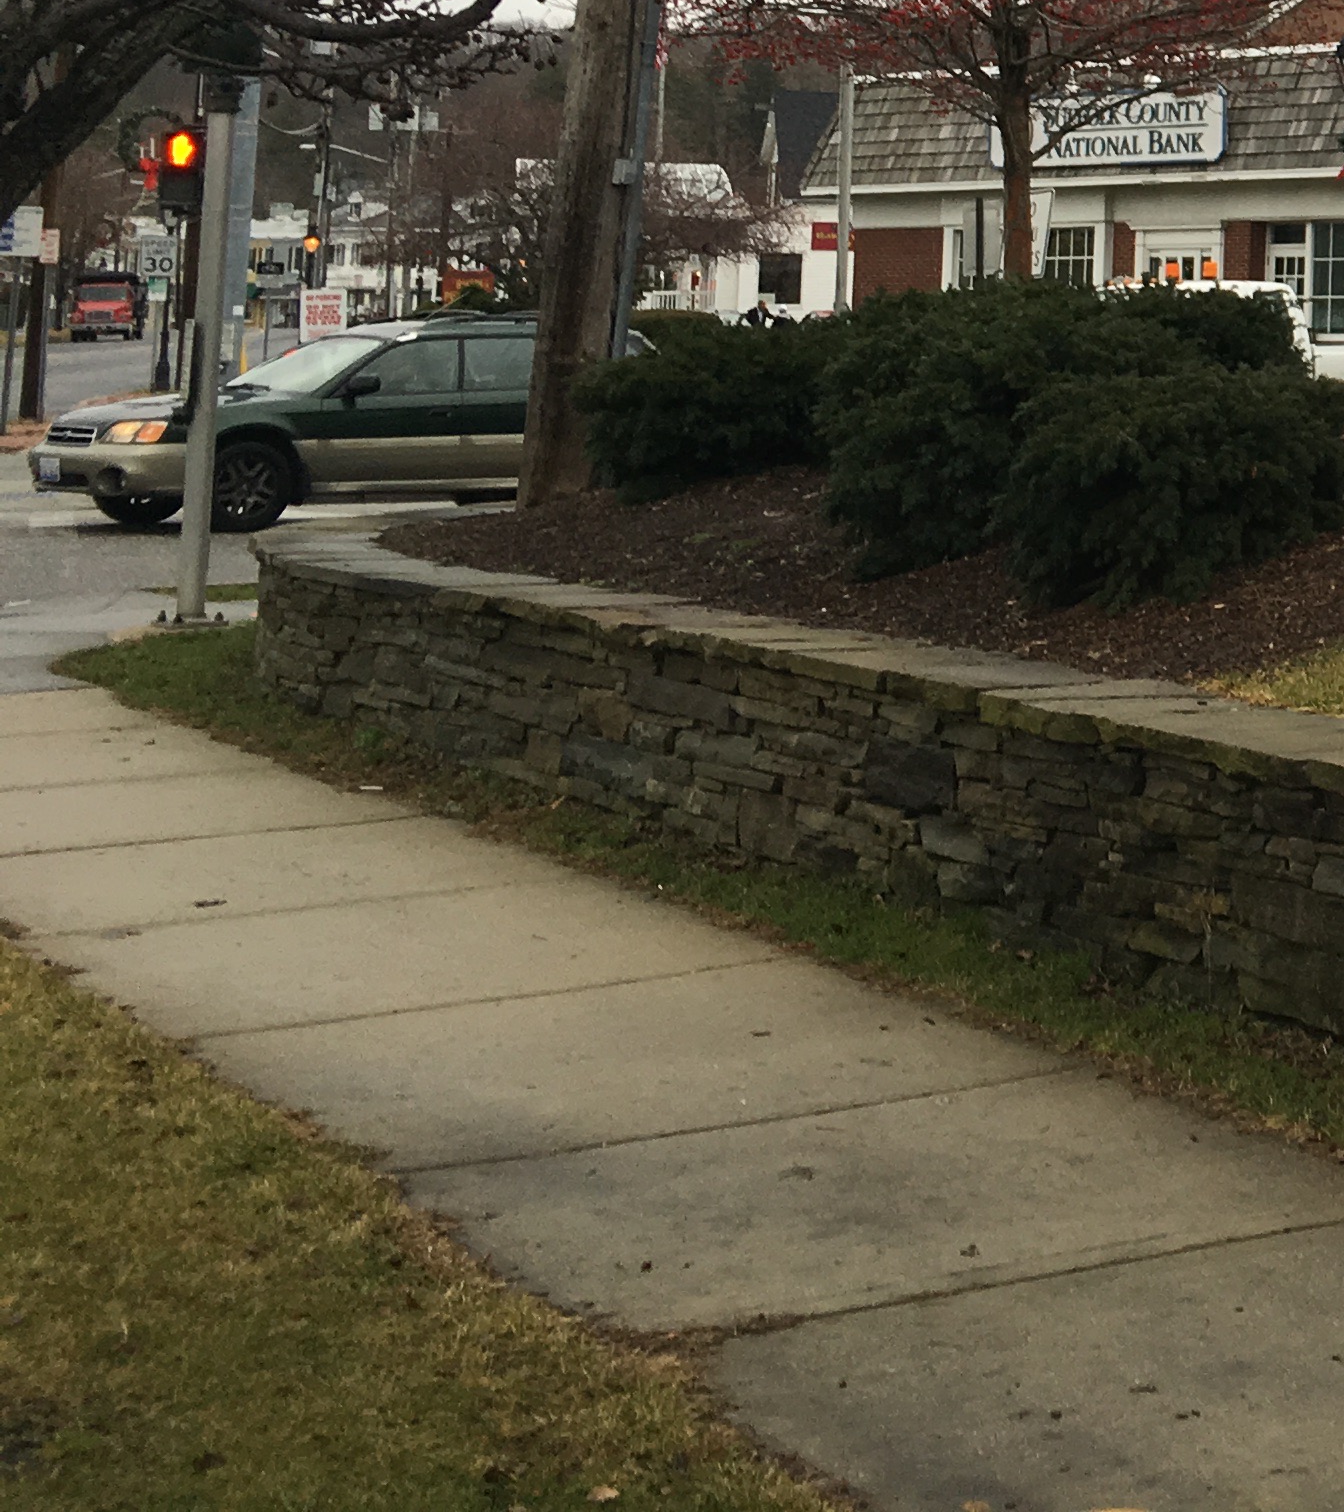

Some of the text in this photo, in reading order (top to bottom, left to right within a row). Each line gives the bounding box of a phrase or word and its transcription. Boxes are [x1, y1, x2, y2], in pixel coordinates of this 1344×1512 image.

[1125, 100, 1208, 125] COUNTY
[1046, 129, 1205, 159] NATIONAL BANK
[144, 256, 174, 273] 30
